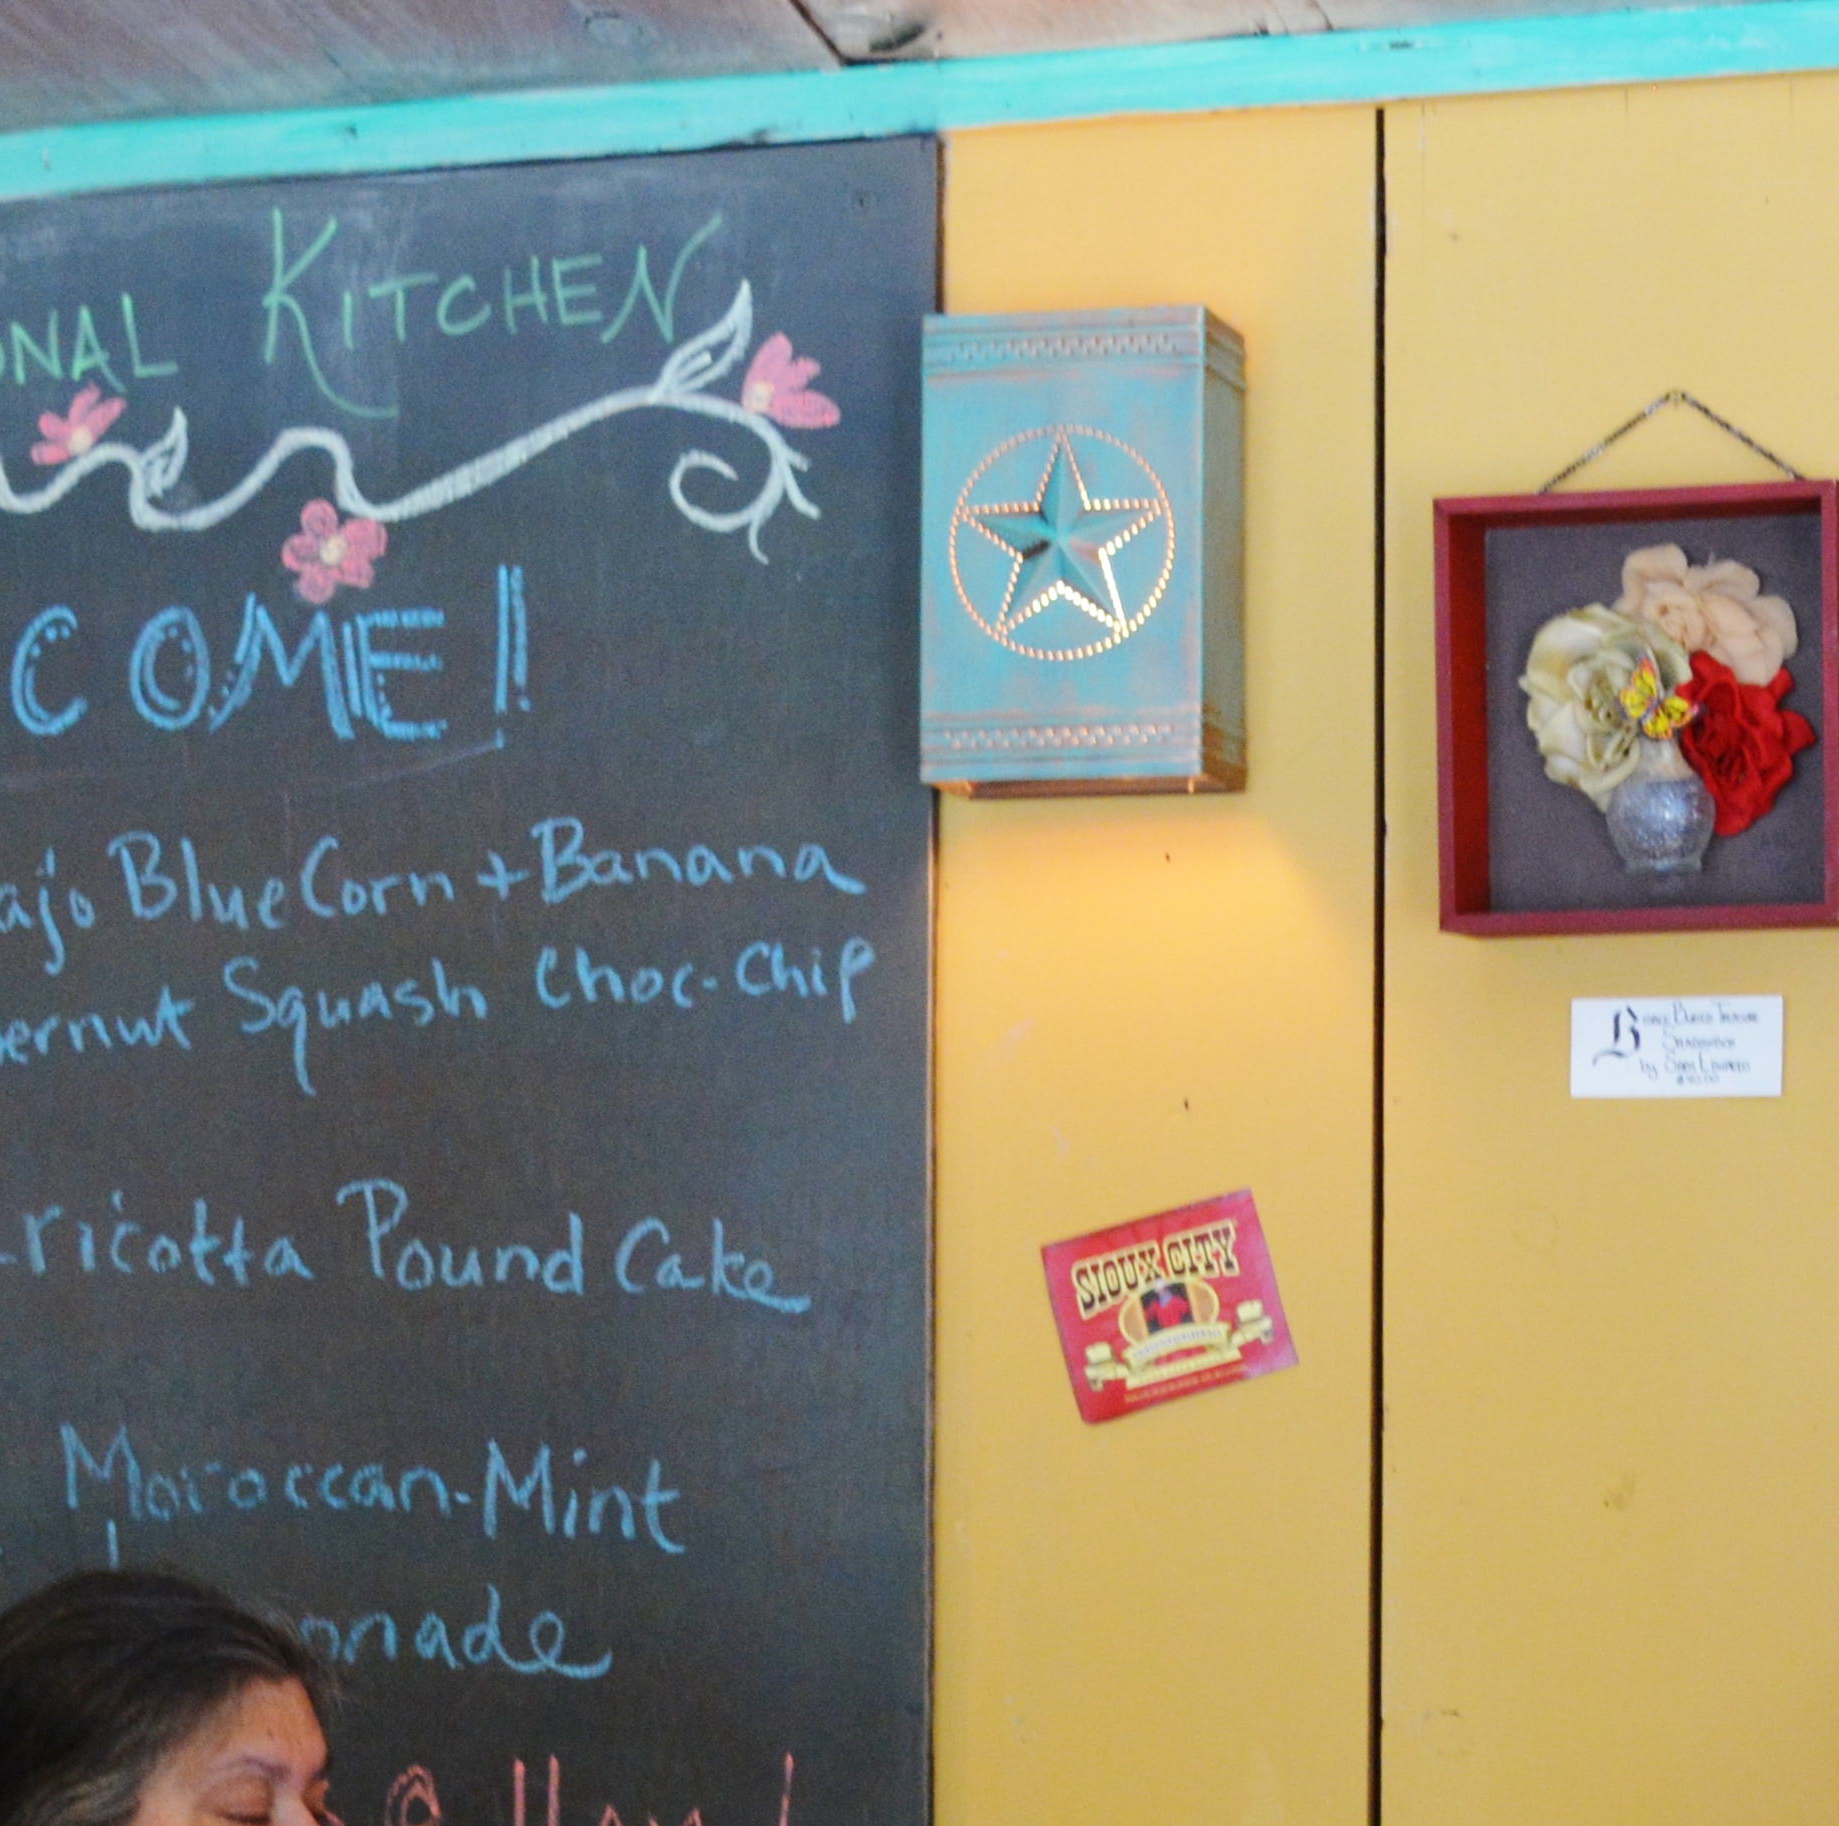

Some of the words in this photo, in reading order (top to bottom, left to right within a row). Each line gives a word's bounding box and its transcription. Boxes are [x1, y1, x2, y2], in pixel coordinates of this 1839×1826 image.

[223, 957, 487, 1097] Squash
[338, 1178, 584, 1296] Pound
[615, 1217, 811, 1314] Cake
[1073, 1244, 1163, 1315] SIOUX
[1165, 1222, 1237, 1275] CITY
